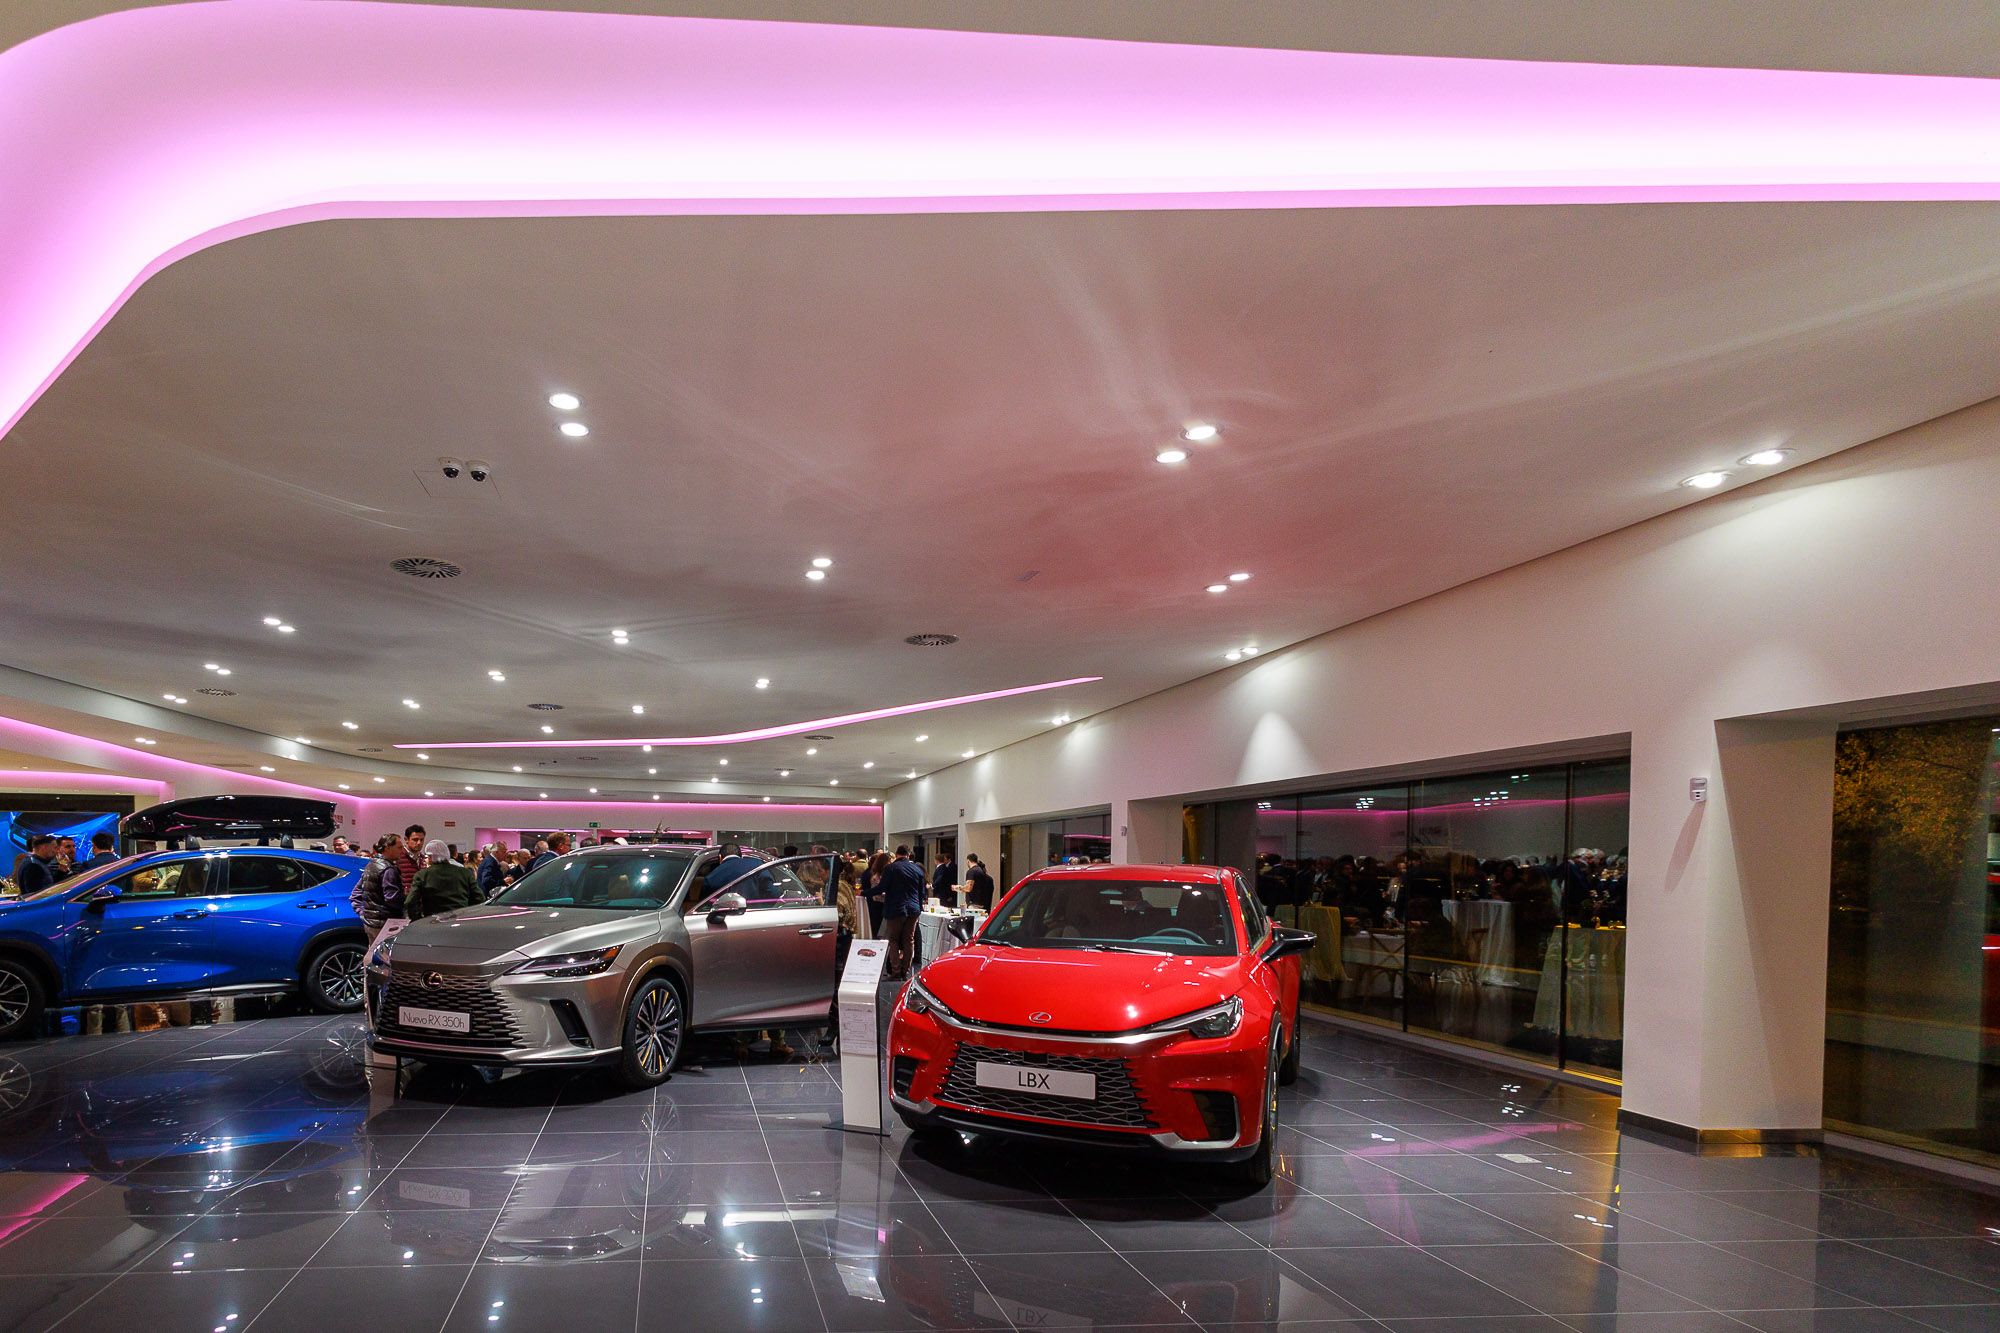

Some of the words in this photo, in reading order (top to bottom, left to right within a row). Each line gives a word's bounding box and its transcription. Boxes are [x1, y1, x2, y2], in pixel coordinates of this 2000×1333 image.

[403, 1011, 428, 1024] Nuevo
[428, 1014, 441, 1026] RX
[441, 1015, 465, 1028] 350h
[1018, 1071, 1050, 1090] LBX
